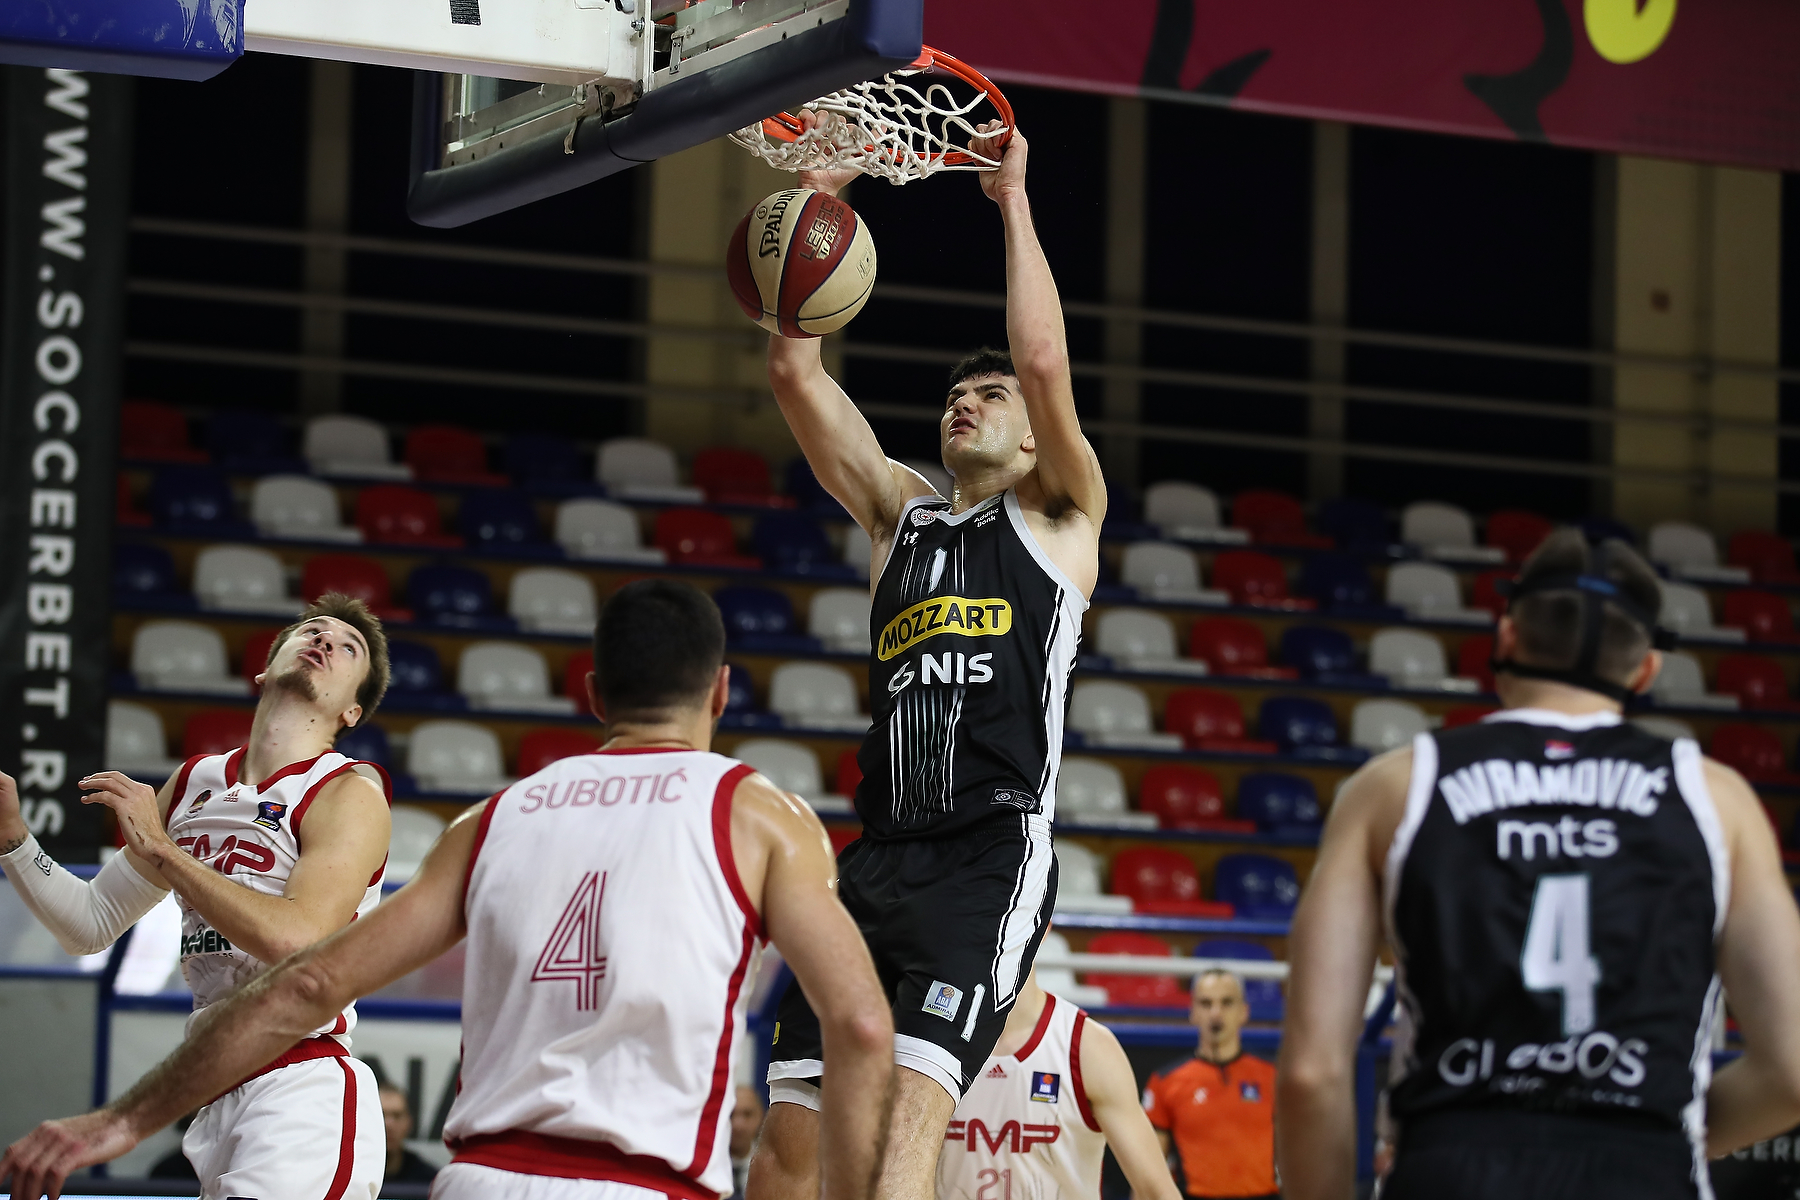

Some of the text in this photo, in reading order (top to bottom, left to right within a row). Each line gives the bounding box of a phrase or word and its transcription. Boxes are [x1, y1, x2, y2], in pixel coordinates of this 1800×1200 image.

[758, 189, 806, 259] SPALDIN
[928, 546, 948, 595] 1
[880, 602, 1006, 656] MOZZART
[921, 652, 994, 685] NIS
[518, 767, 688, 815] SUBOTIĆ
[1438, 756, 1670, 826] AVRAMOVIĆ
[1496, 814, 1620, 861] mts
[530, 870, 608, 1012] 4
[1519, 872, 1602, 1036] 4
[960, 983, 987, 1043] 1
